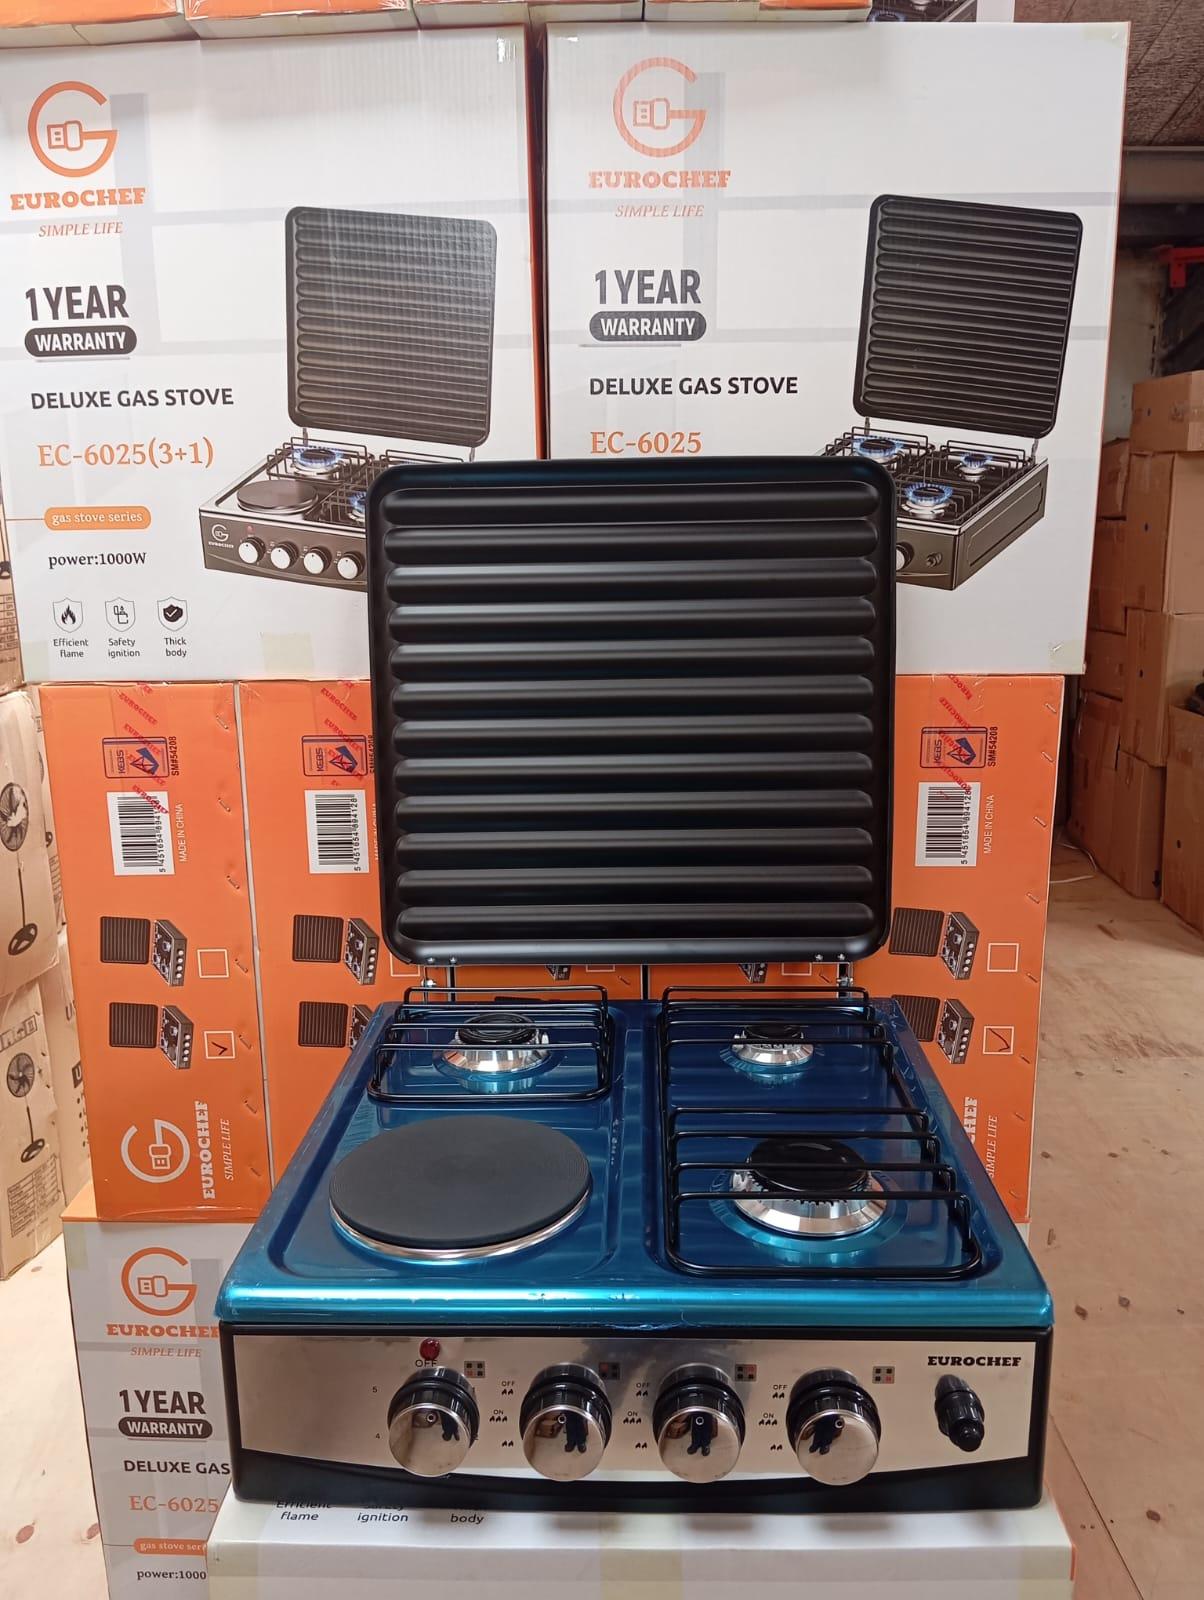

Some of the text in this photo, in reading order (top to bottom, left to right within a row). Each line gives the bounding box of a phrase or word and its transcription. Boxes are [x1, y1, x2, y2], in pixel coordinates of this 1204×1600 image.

[588, 169, 731, 189] EUROCHEF
[10, 187, 146, 211] EUROCHEF
[615, 204, 704, 218] SIMPLE LIFE
[38, 221, 123, 237] SIMPLE LIFE
[600, 317, 697, 337] WARRANTY
[34, 331, 126, 353] WARRANTY
[589, 377, 798, 397] DELUXE GAS STOVE
[31, 388, 234, 410] DELUXE GAS STOVE
[590, 431, 702, 455] EC-6025
[37, 436, 214, 469] EC-6025(3+1)
[51, 511, 143, 525] gas stove series
[48, 552, 147, 569] power:1000W
[53, 638, 89, 648] Efficient
[108, 638, 136, 648] Safety
[164, 637, 187, 646] Thick
[60, 649, 84, 658] flame
[108, 649, 140, 659] ignition
[165, 648, 187, 658] body
[988, 726, 998, 767] SM#54208
[116, 749, 125, 774] KEBS
[168, 736, 179, 776] SM#54208
[316, 748, 324, 772] KEBS
[176, 803, 185, 829] CHINA
[984, 829, 992, 854] MADE
[177, 840, 187, 862] MADE
[988, 1115, 998, 1137] LIFE
[195, 1101, 215, 1199] EUROCHEF
[220, 1119, 234, 1180] SIMPLE LIFE
[131, 1346, 201, 1357] SIMPLE LIFE
[415, 1359, 438, 1367] OFF
[928, 1356, 1021, 1367] EUROCHEF
[127, 1421, 203, 1435] WARRANTY
[124, 1460, 231, 1475] DELUXE GAS
[129, 1495, 219, 1512] EC-6025
[280, 1511, 319, 1521] flame
[357, 1511, 409, 1523] ignition
[450, 1513, 484, 1525] body
[139, 1542, 156, 1551] gas
[159, 1541, 184, 1550] stove
